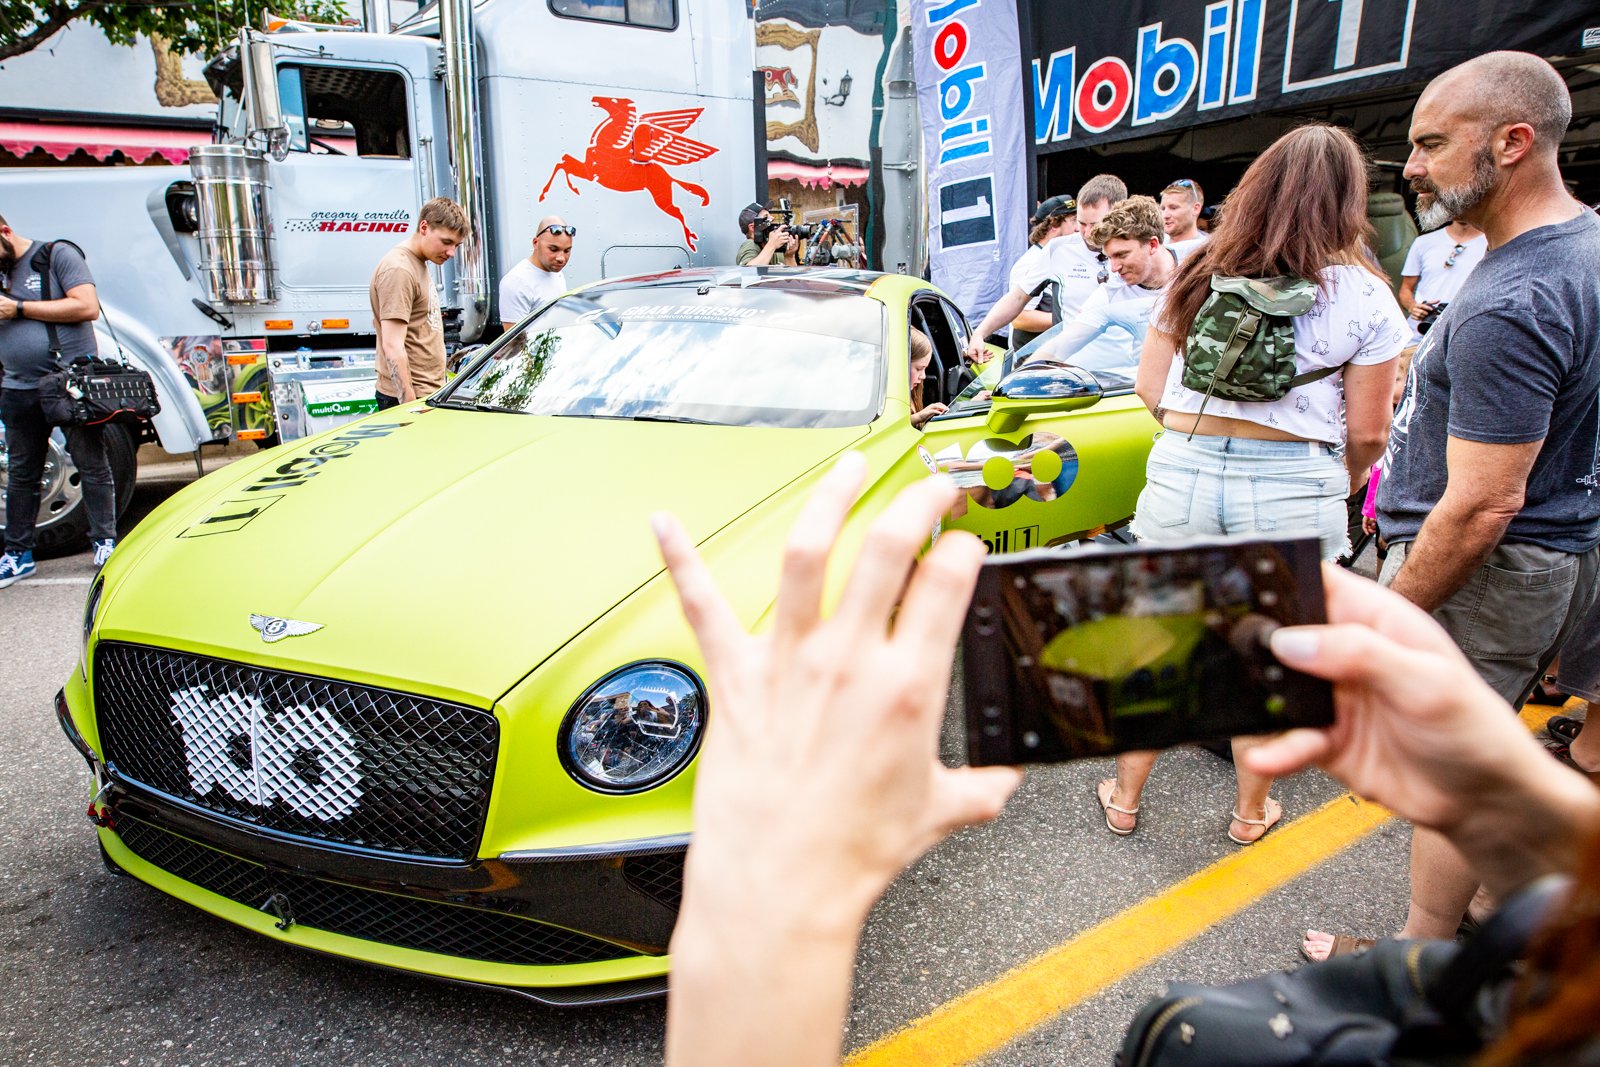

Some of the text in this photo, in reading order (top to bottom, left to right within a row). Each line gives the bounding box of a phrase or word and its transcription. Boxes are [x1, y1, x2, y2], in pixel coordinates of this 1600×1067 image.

[1032, 0, 1266, 145] Mobil
[311, 210, 410, 222] gregory carrillo
[319, 221, 409, 233] RACING
[621, 305, 757, 318] GRAN TURISMO
[312, 403, 350, 414] multiQue
[241, 421, 415, 492] Mobil
